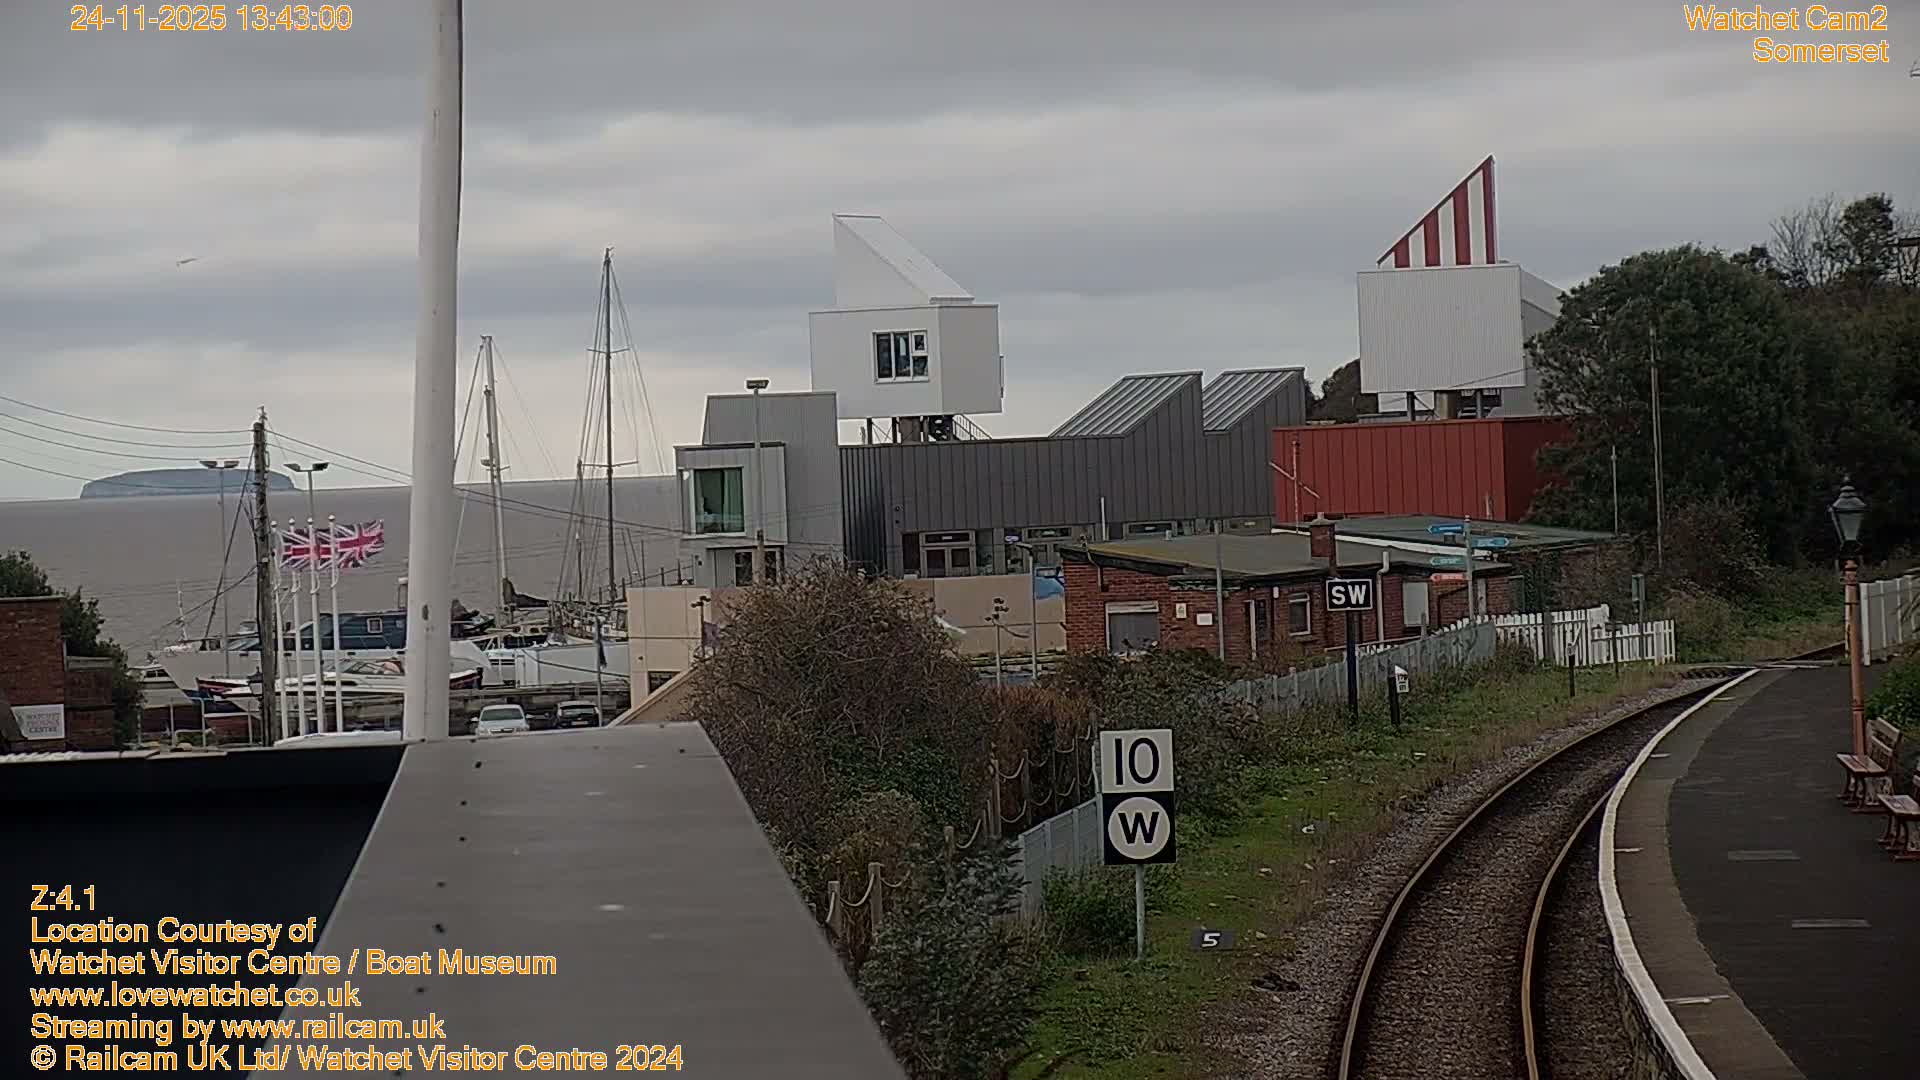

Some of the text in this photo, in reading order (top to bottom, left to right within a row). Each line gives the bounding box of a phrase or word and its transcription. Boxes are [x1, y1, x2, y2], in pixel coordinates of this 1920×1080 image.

[1331, 585, 1366, 605] SW
[1114, 737, 1160, 786] 10
[1118, 811, 1160, 845] W
[1201, 932, 1221, 948] 5
